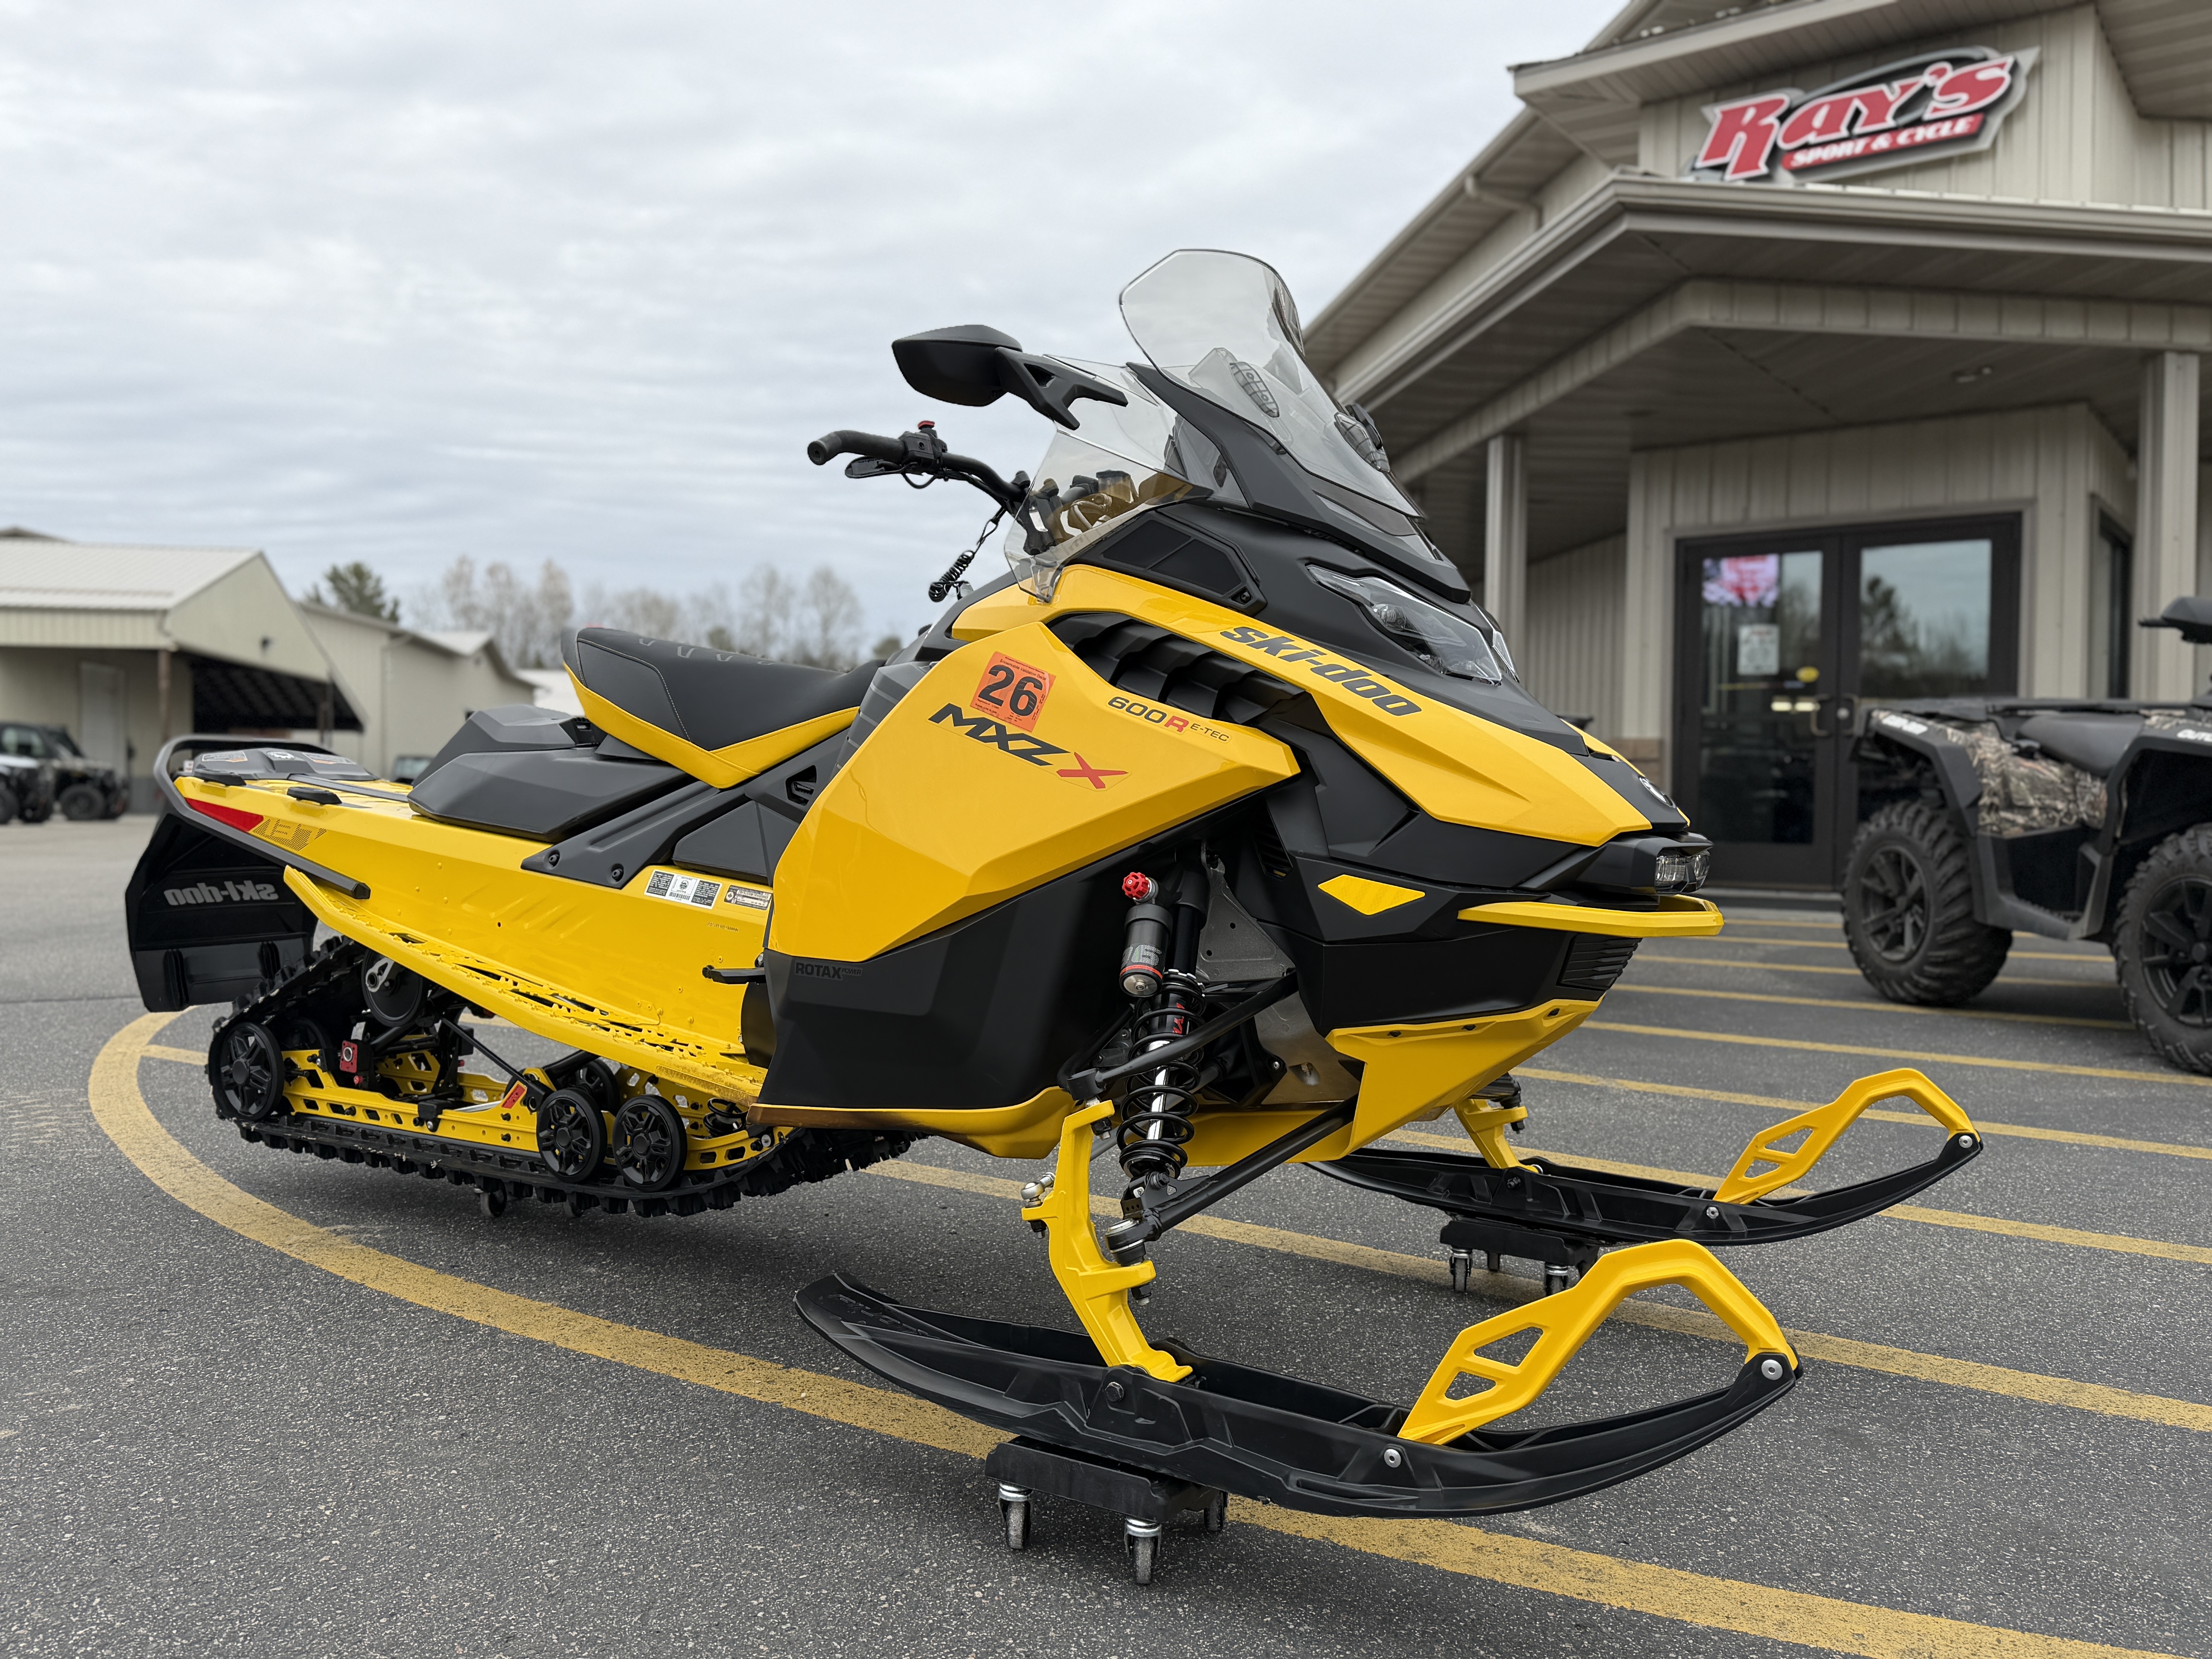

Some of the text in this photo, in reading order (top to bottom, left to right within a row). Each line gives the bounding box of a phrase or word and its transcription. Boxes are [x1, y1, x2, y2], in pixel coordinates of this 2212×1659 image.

[1695, 55, 2015, 181] Ray's
[1791, 116, 1975, 167] SPORT & CYCLE
[978, 664, 1043, 716] 26
[1220, 626, 1422, 716] ski-doo
[928, 702, 1071, 767] MXZ
[1056, 751, 1130, 789] X
[1108, 697, 1229, 742] 600R E-TEC
[796, 962, 842, 979] ROTAX
